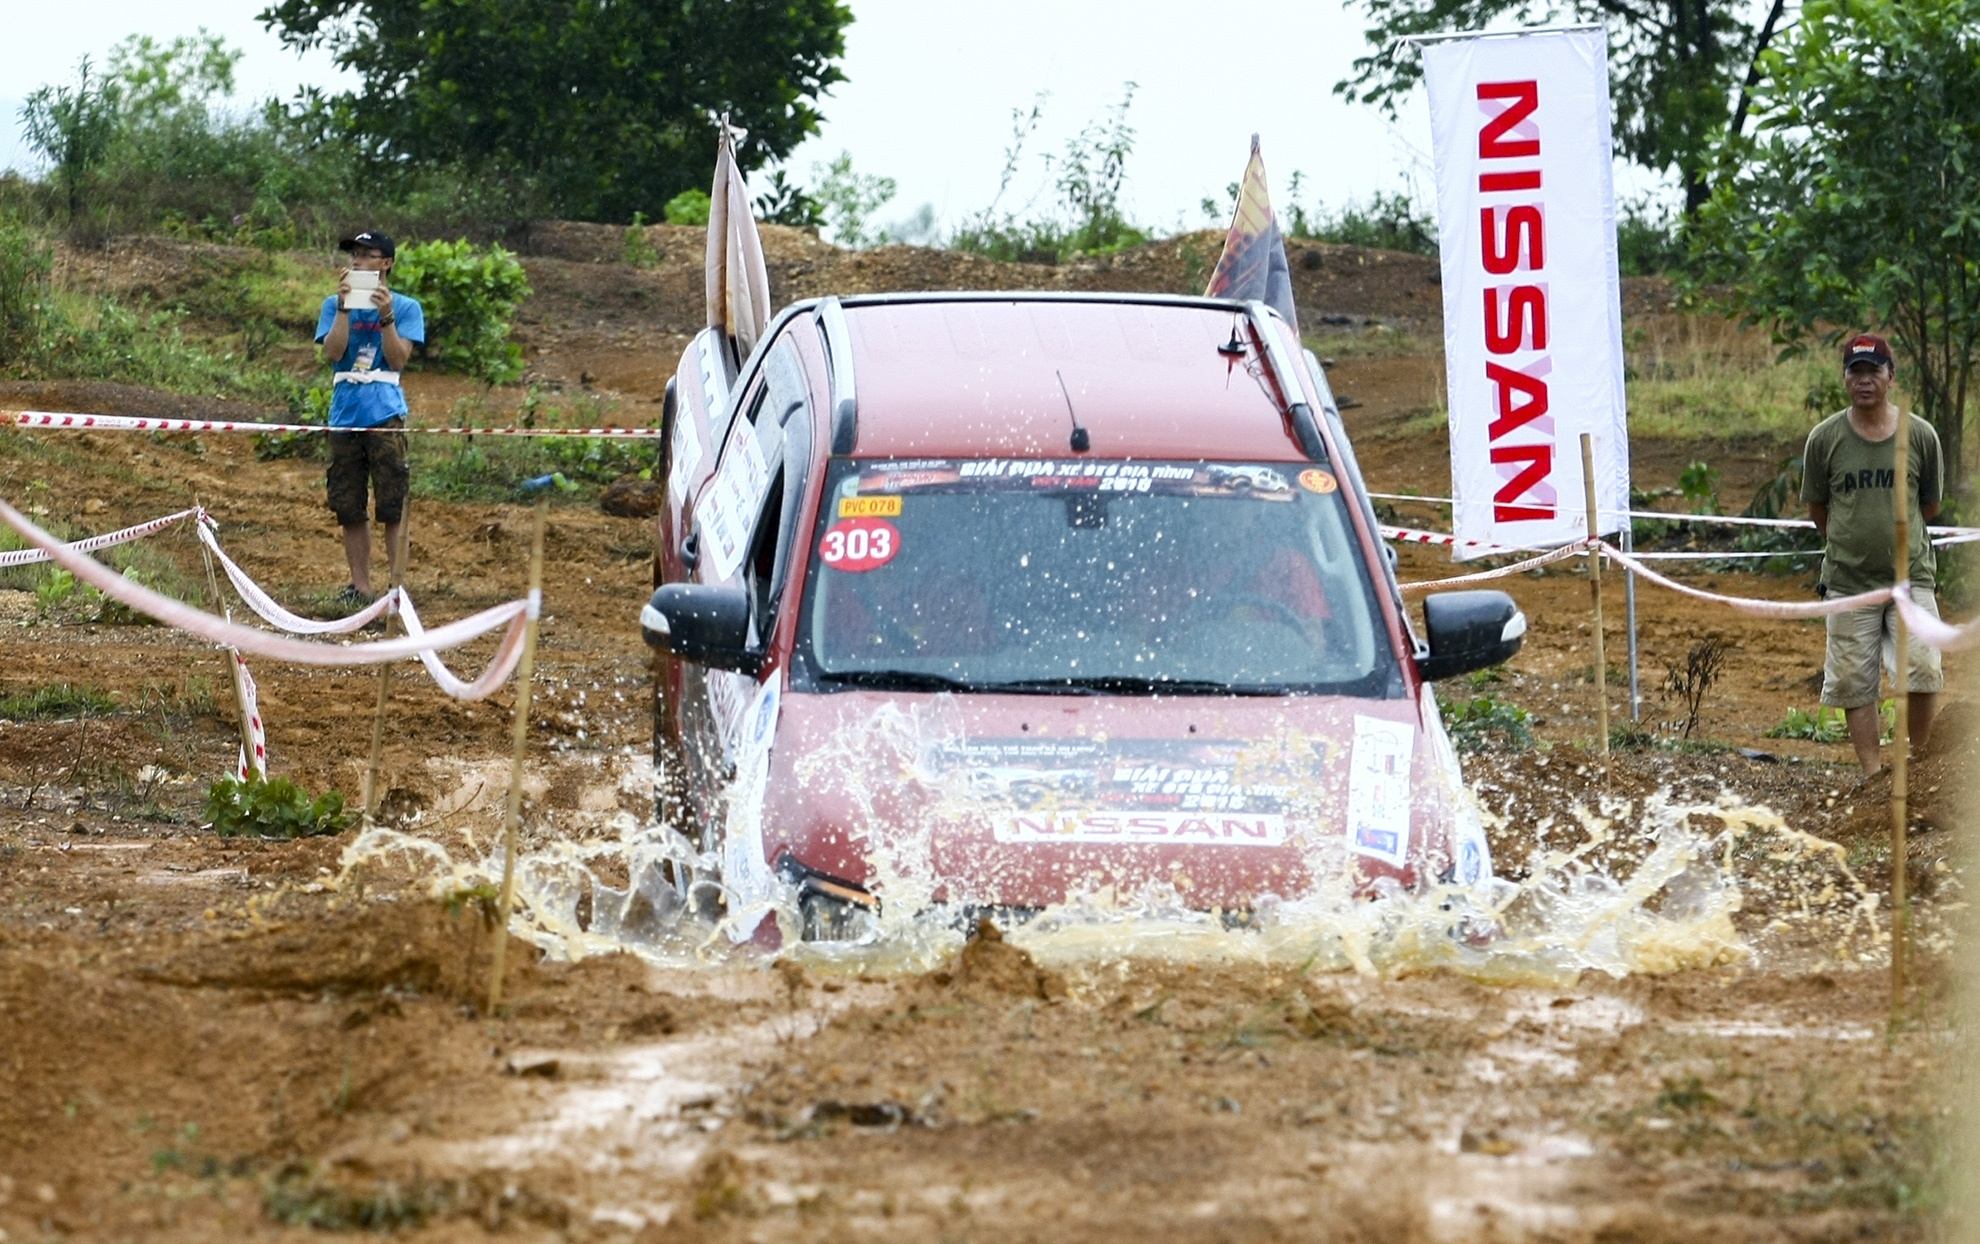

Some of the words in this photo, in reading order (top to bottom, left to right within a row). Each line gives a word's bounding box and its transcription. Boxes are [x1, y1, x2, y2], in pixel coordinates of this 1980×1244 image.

[1476, 79, 1556, 523] NISSAN
[1845, 469, 1909, 491] ARM
[845, 500, 866, 513] PVC
[869, 499, 895, 513] 078
[824, 528, 891, 563] 303
[1011, 817, 1268, 838] NISSAN
